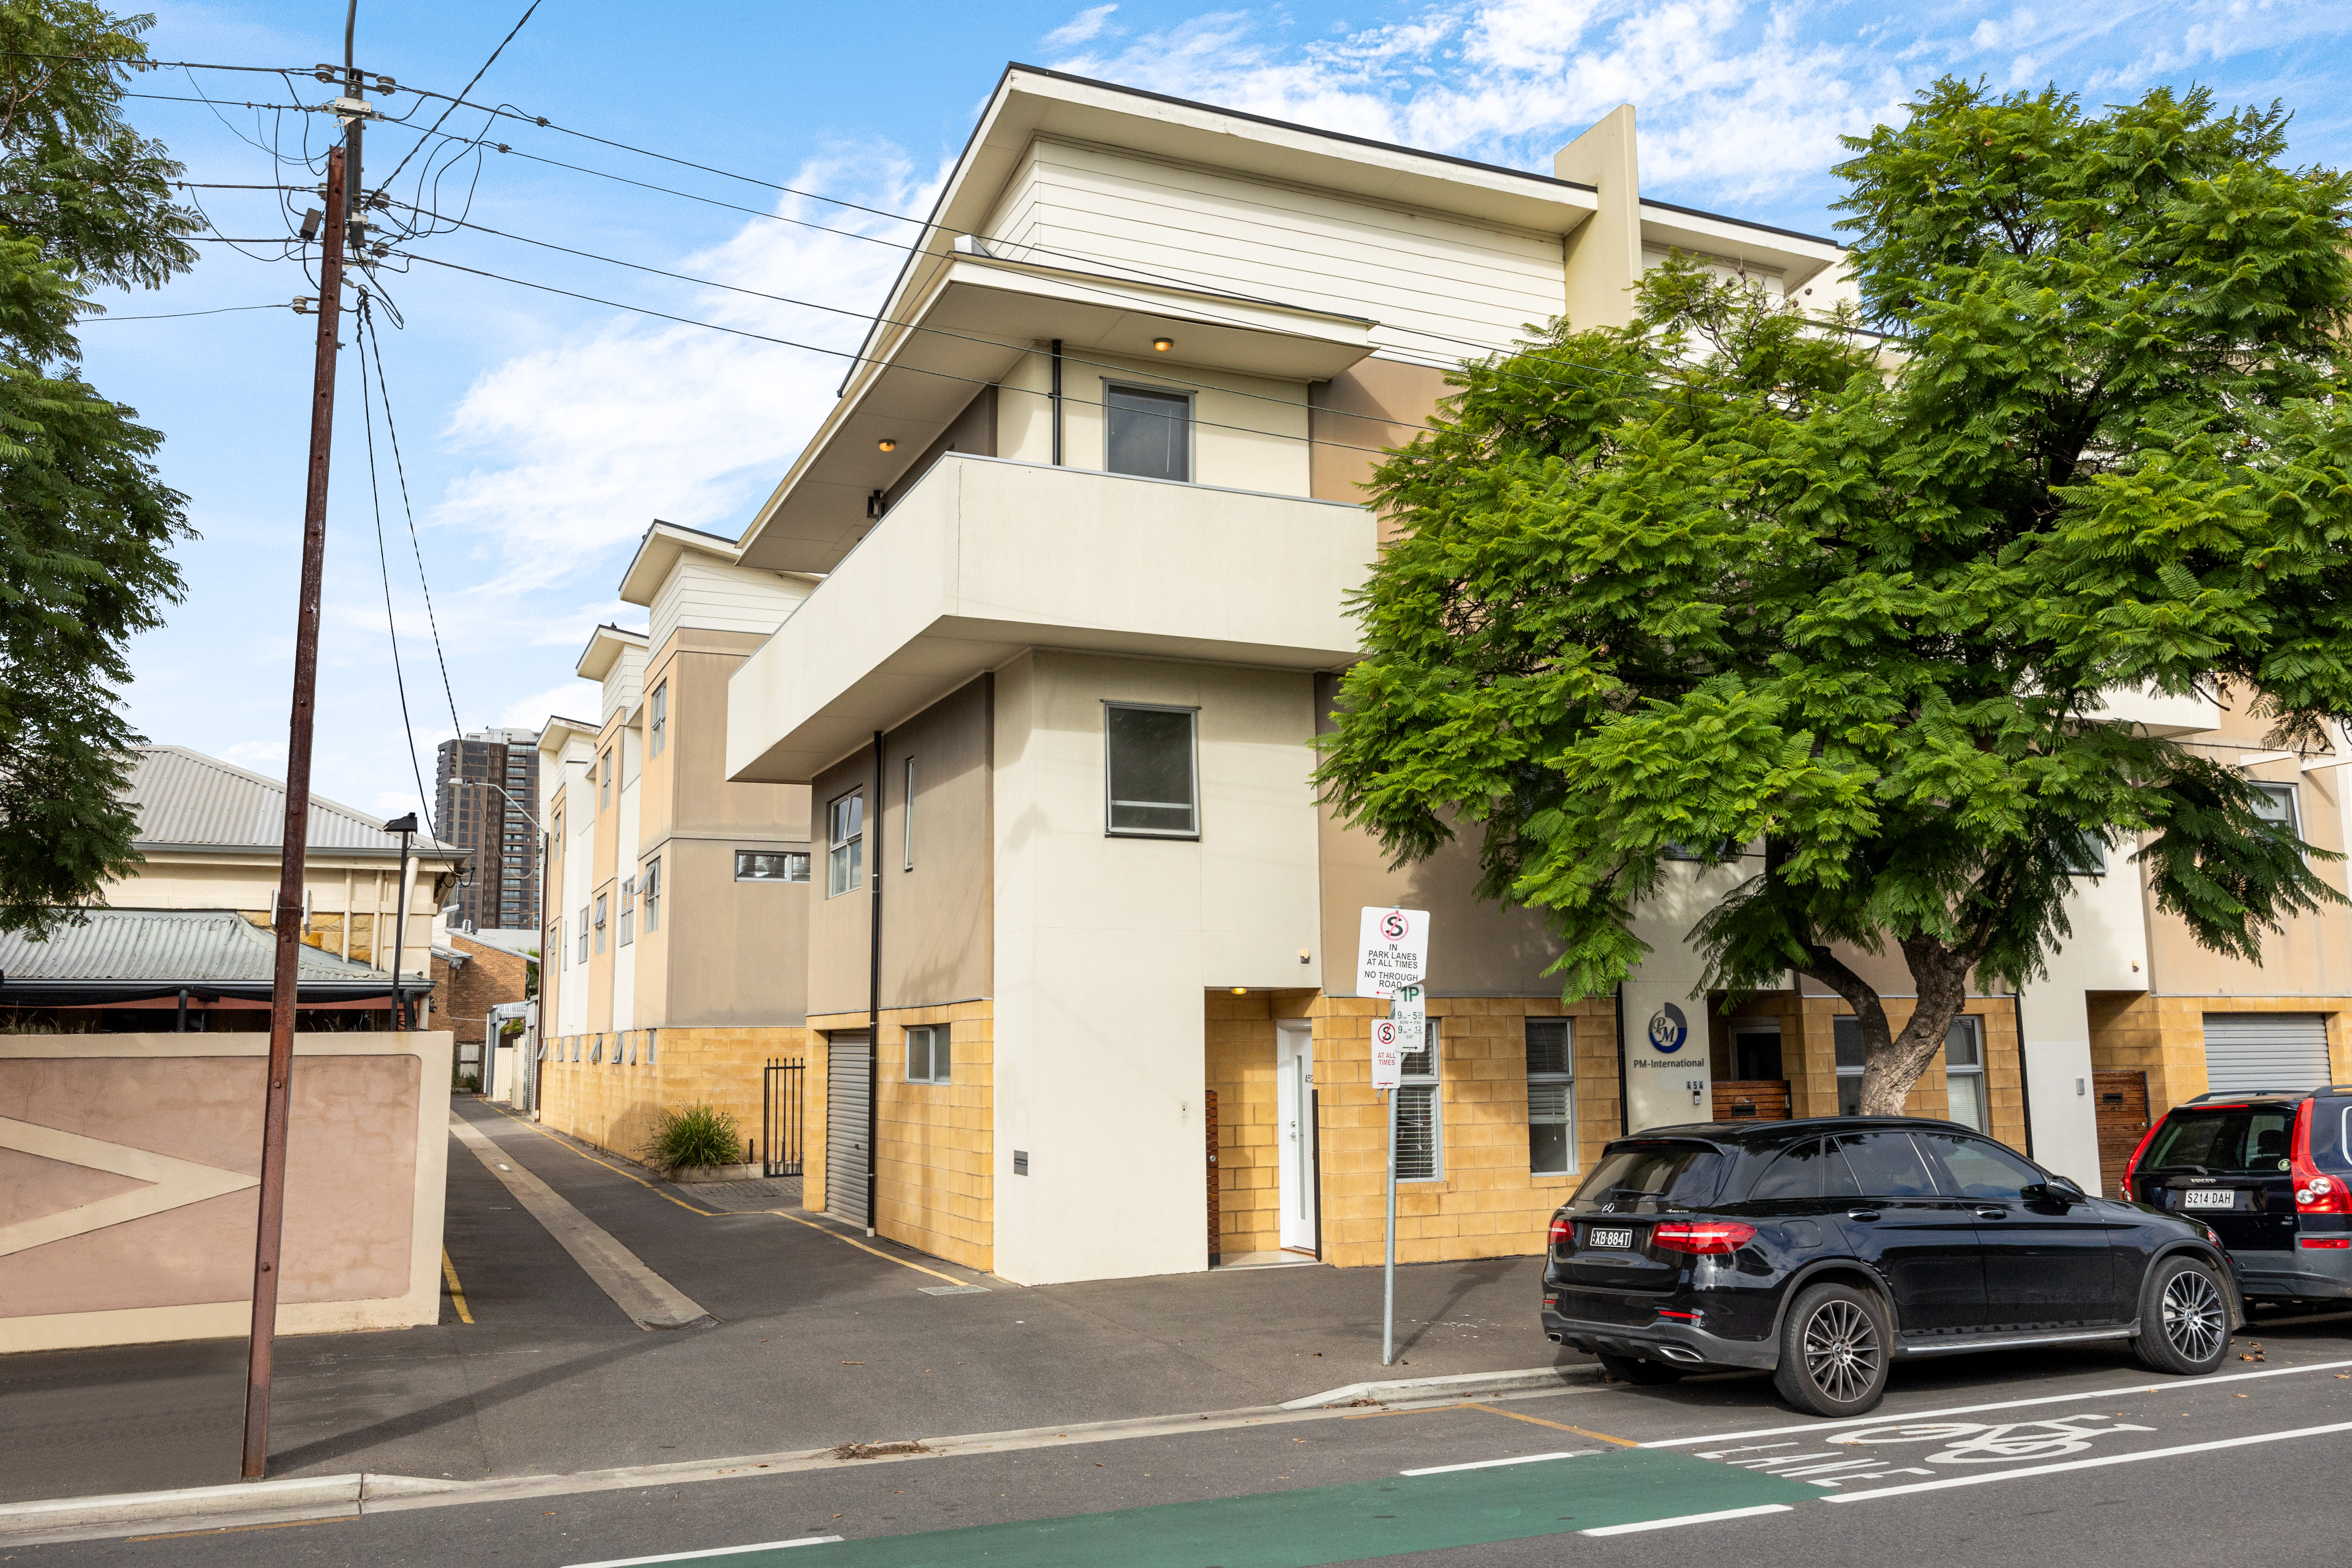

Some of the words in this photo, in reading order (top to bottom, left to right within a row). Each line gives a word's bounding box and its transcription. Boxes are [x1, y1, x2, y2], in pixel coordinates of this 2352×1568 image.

[1368, 950, 1389, 959] PARK
[1391, 952, 1417, 961] LANES
[1395, 960, 1418, 969] TIMES
[1378, 971, 1418, 982] THROUGH
[1379, 980, 1402, 988] ROAD
[1400, 986, 1419, 1002] 1P
[1397, 1011, 1402, 1019] 9
[1398, 1026, 1403, 1034] 9
[1634, 1058, 1705, 1068] PM-International
[1305, 1074, 1314, 1083] 452
[1686, 1081, 1704, 1090] 454
[1694, 1442, 1937, 1487] LANE
